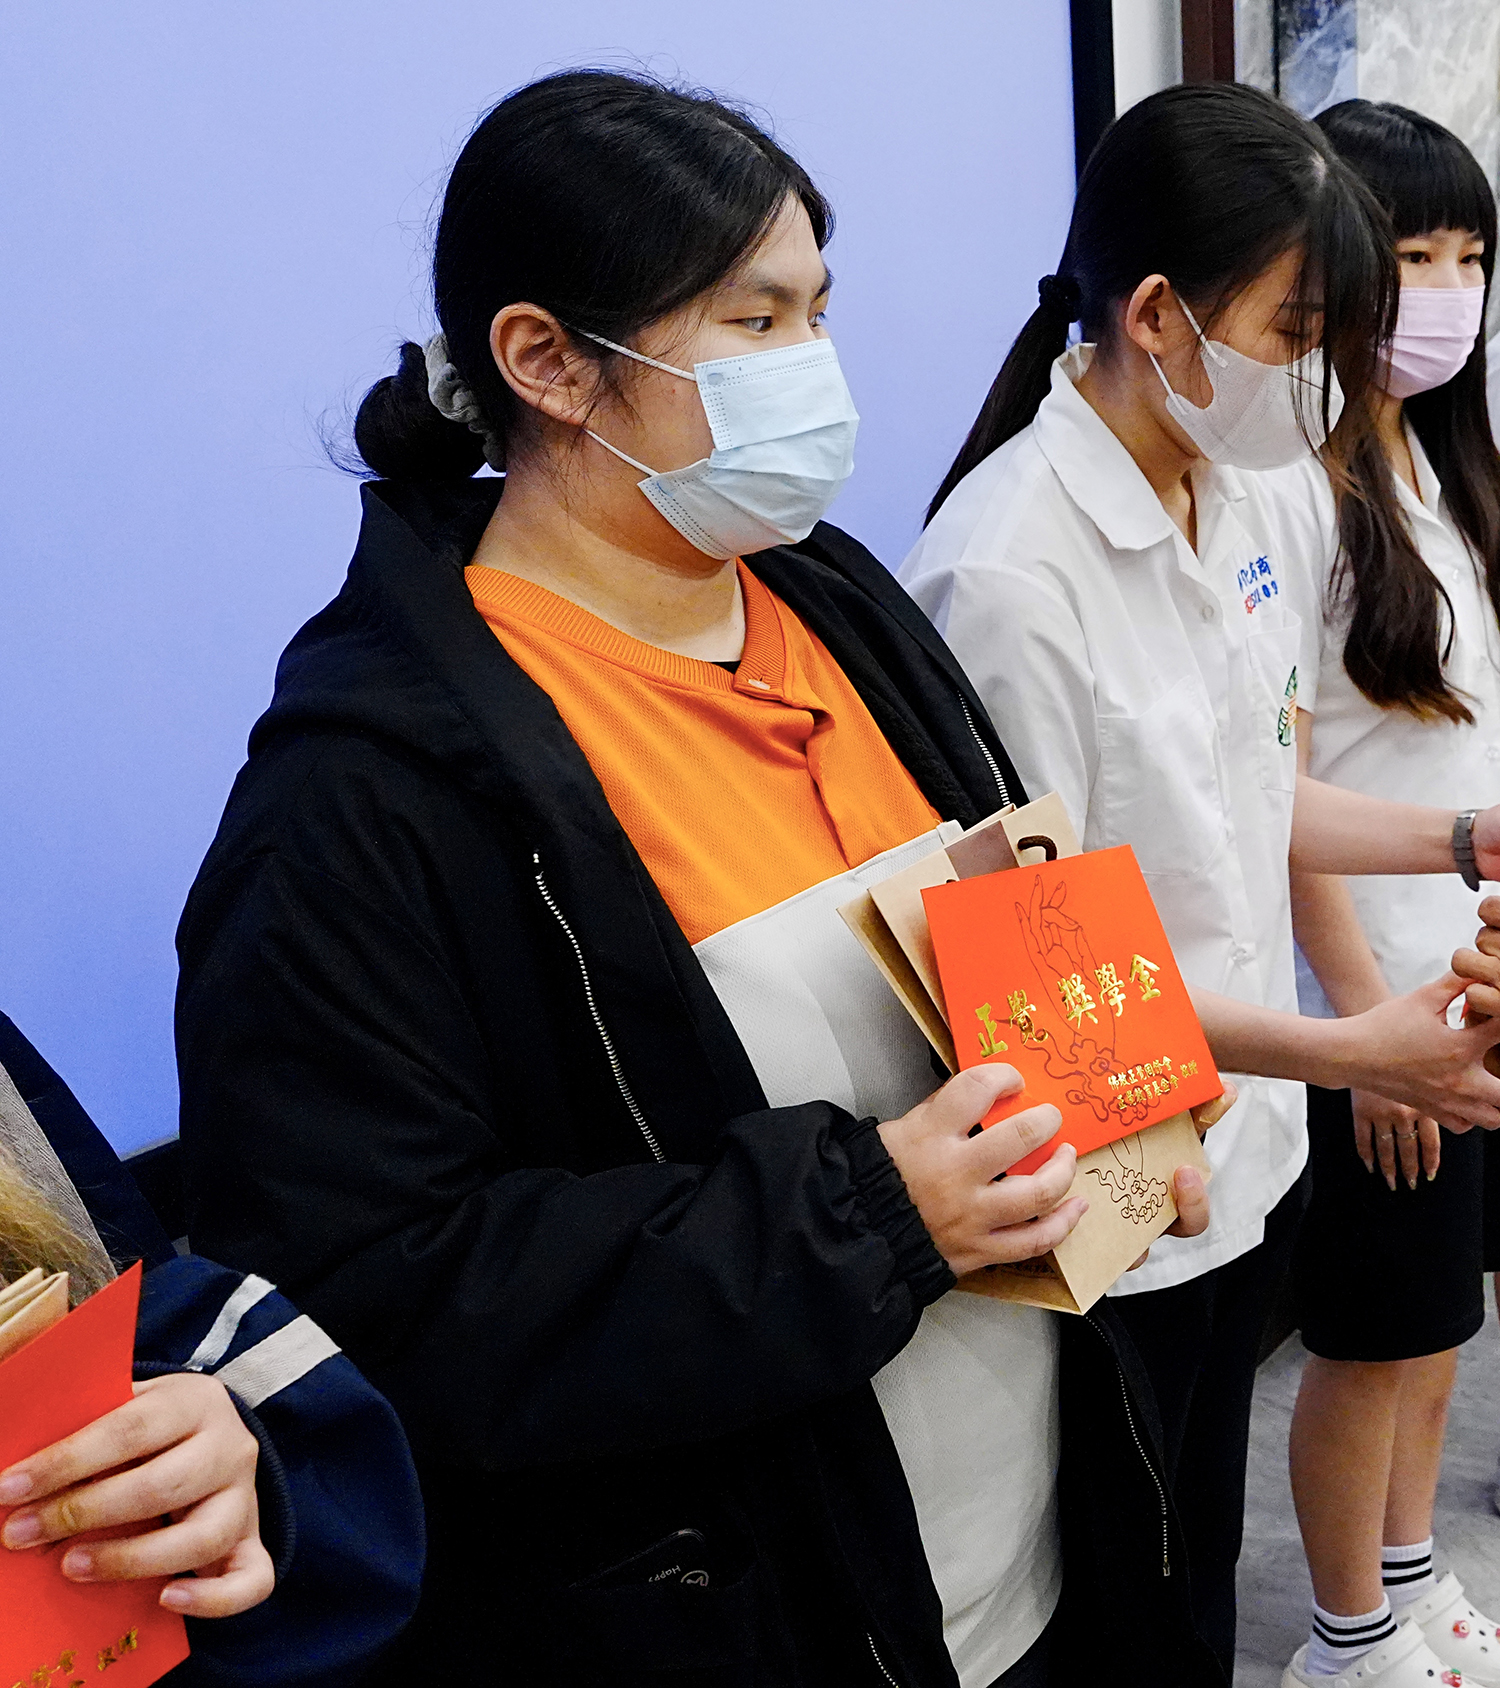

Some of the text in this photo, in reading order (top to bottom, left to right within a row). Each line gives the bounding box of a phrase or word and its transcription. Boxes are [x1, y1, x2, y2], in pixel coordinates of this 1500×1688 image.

[975, 953, 1162, 1058] 正覺 獎學金
